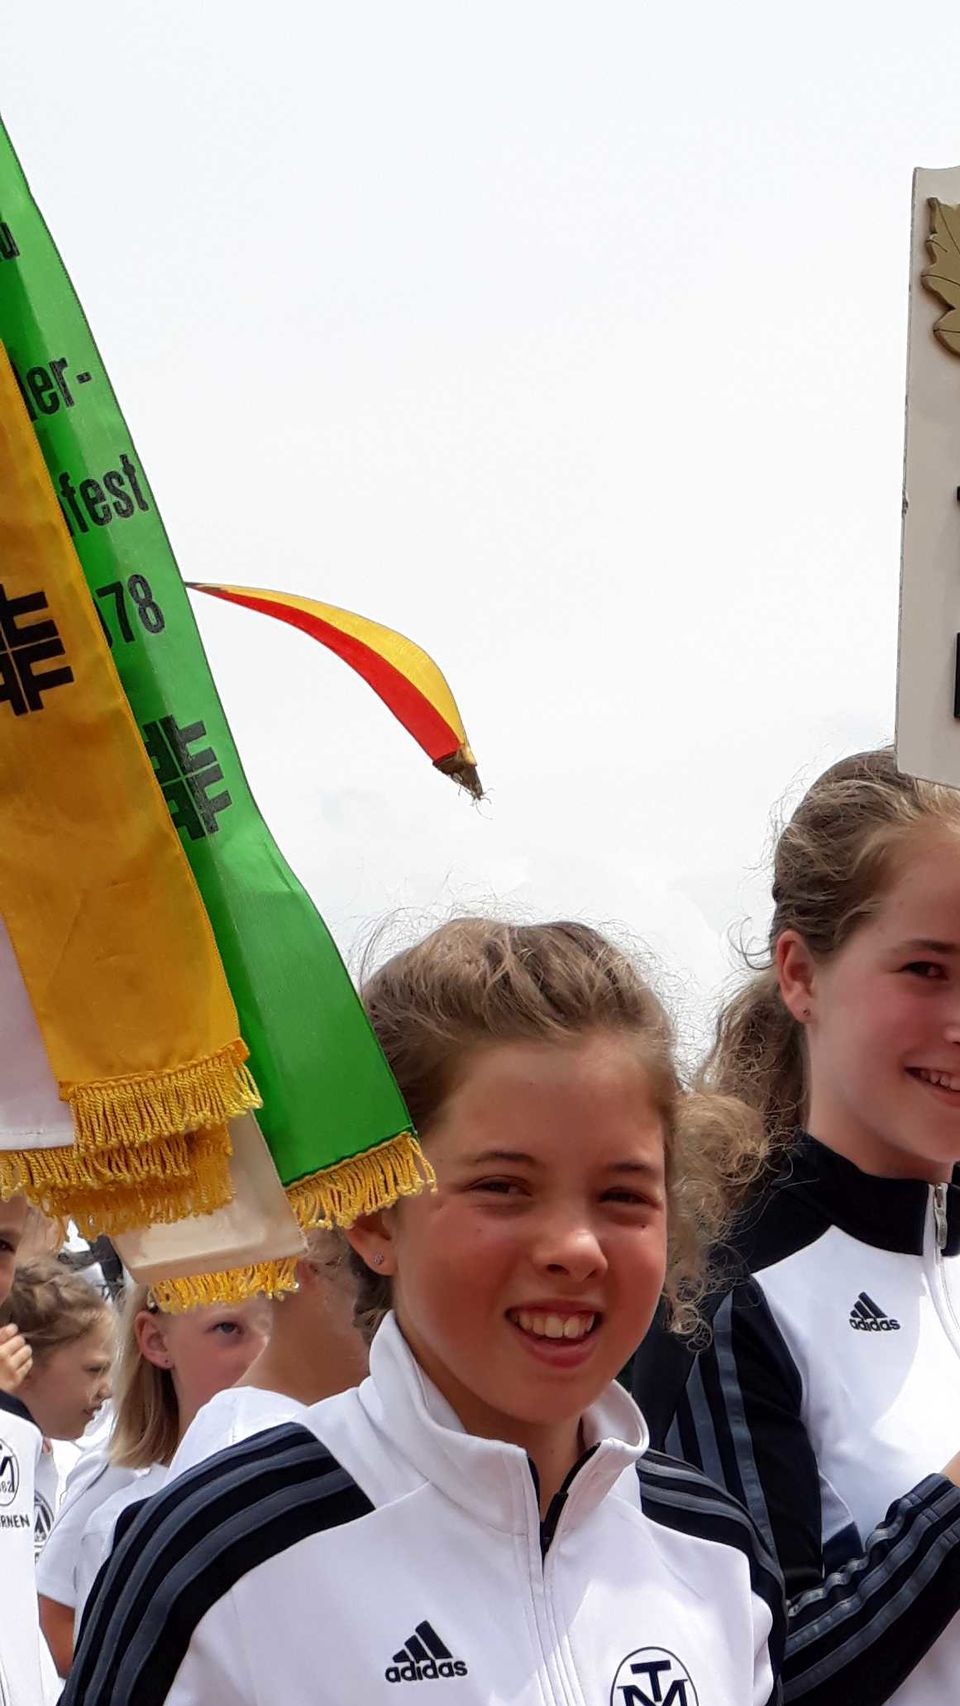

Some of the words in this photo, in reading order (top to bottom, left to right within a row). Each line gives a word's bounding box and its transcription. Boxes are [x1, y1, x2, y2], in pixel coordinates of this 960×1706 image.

[57, 453, 150, 538] fest
[93, 574, 165, 648] 78
[849, 1317, 901, 1332] adidas
[385, 1660, 468, 1683] adidas
